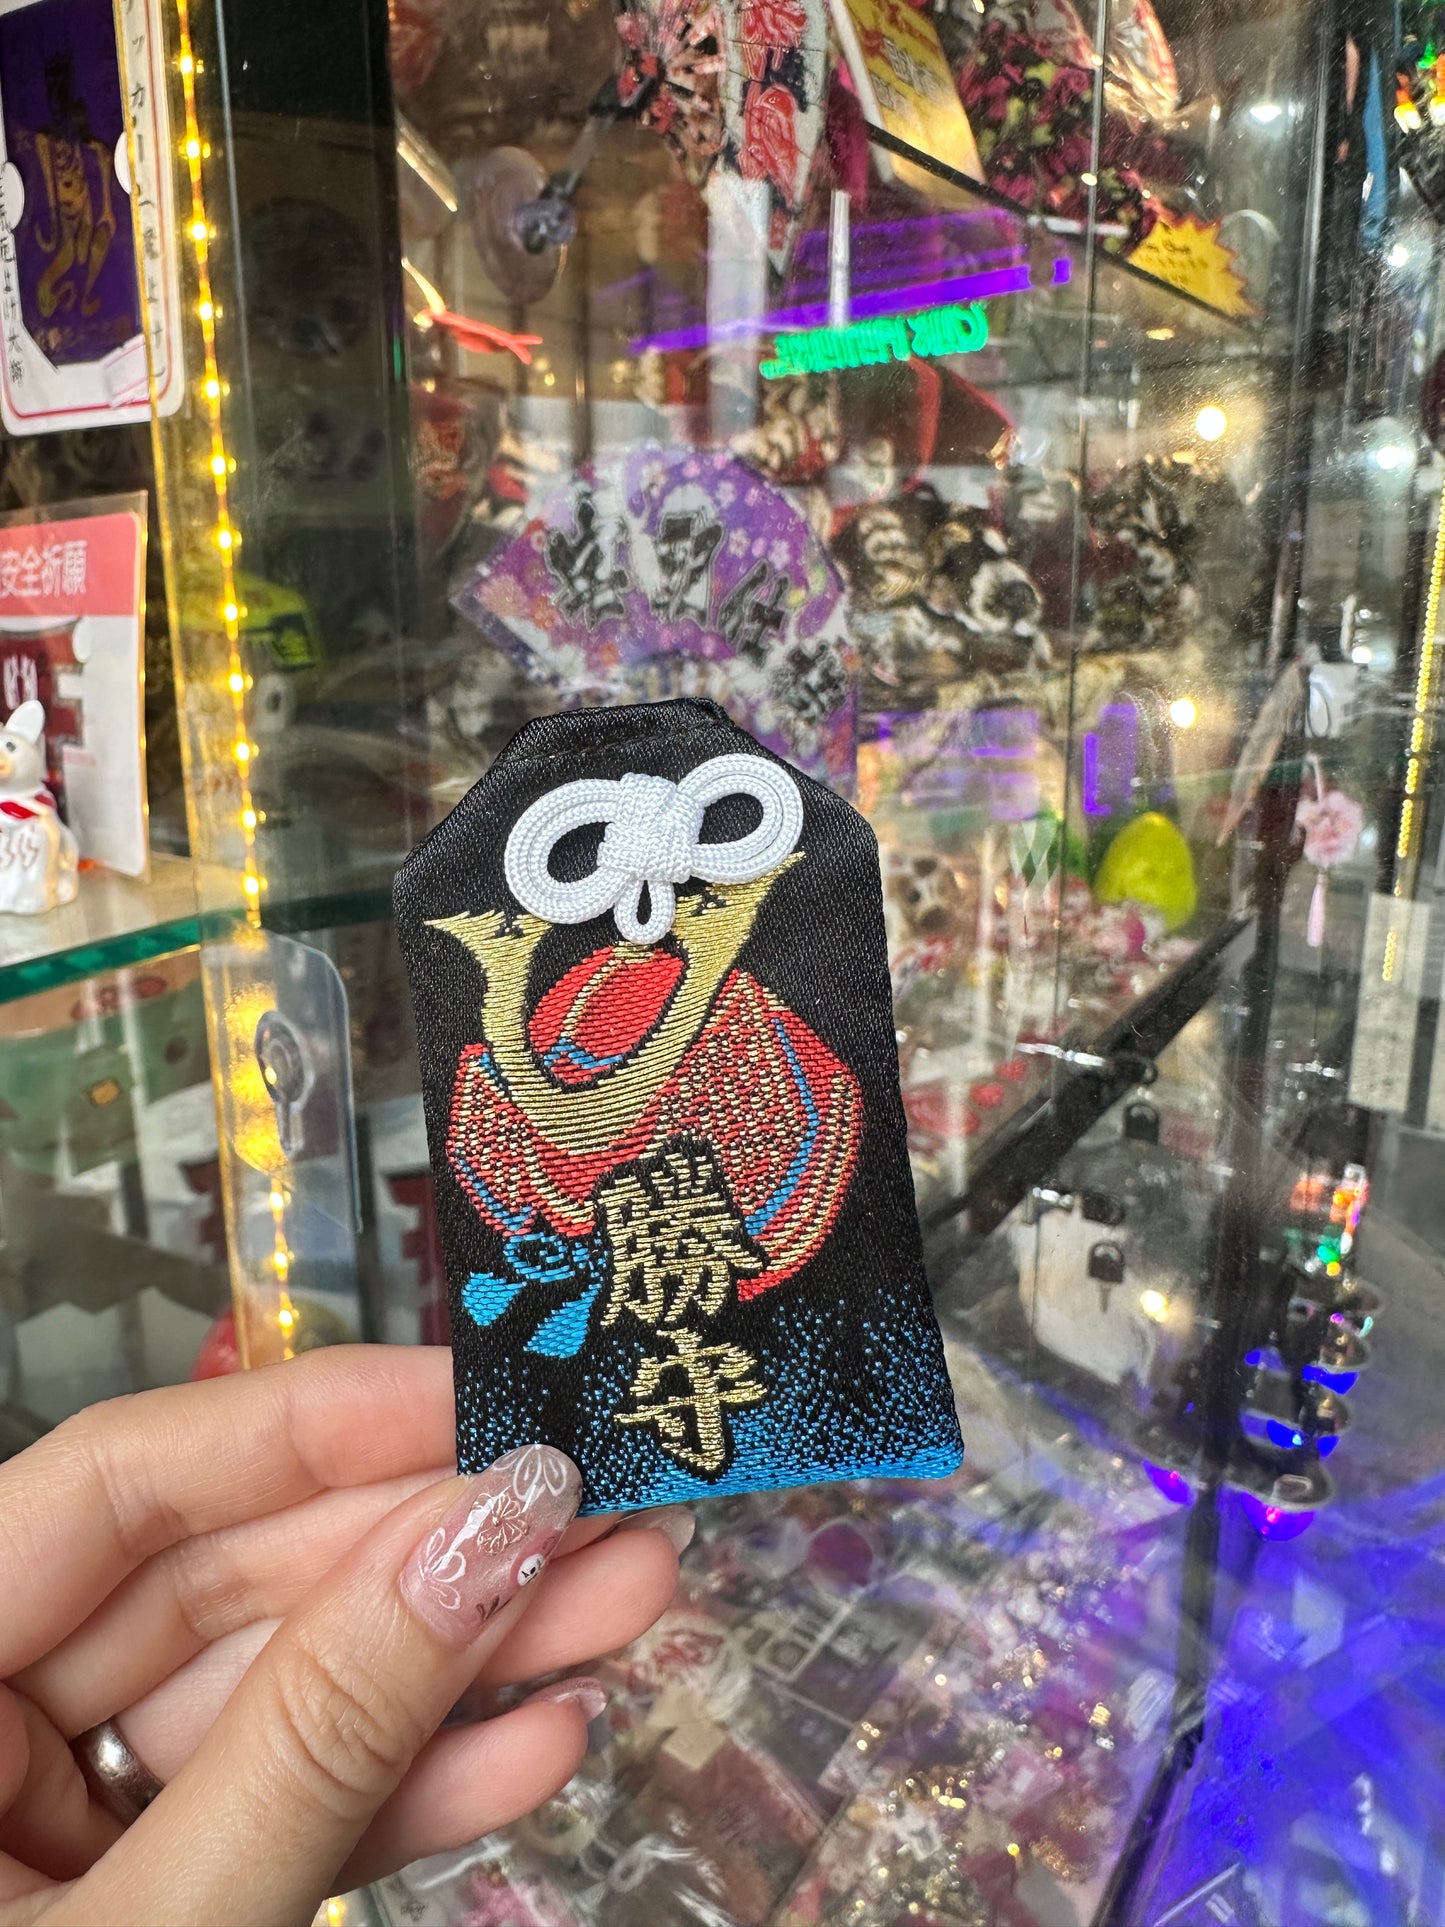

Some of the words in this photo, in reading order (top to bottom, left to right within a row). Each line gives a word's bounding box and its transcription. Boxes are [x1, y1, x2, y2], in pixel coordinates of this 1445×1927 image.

[0, 536, 88, 599] 安全祈願
[600, 1152, 767, 1471] 勝守
